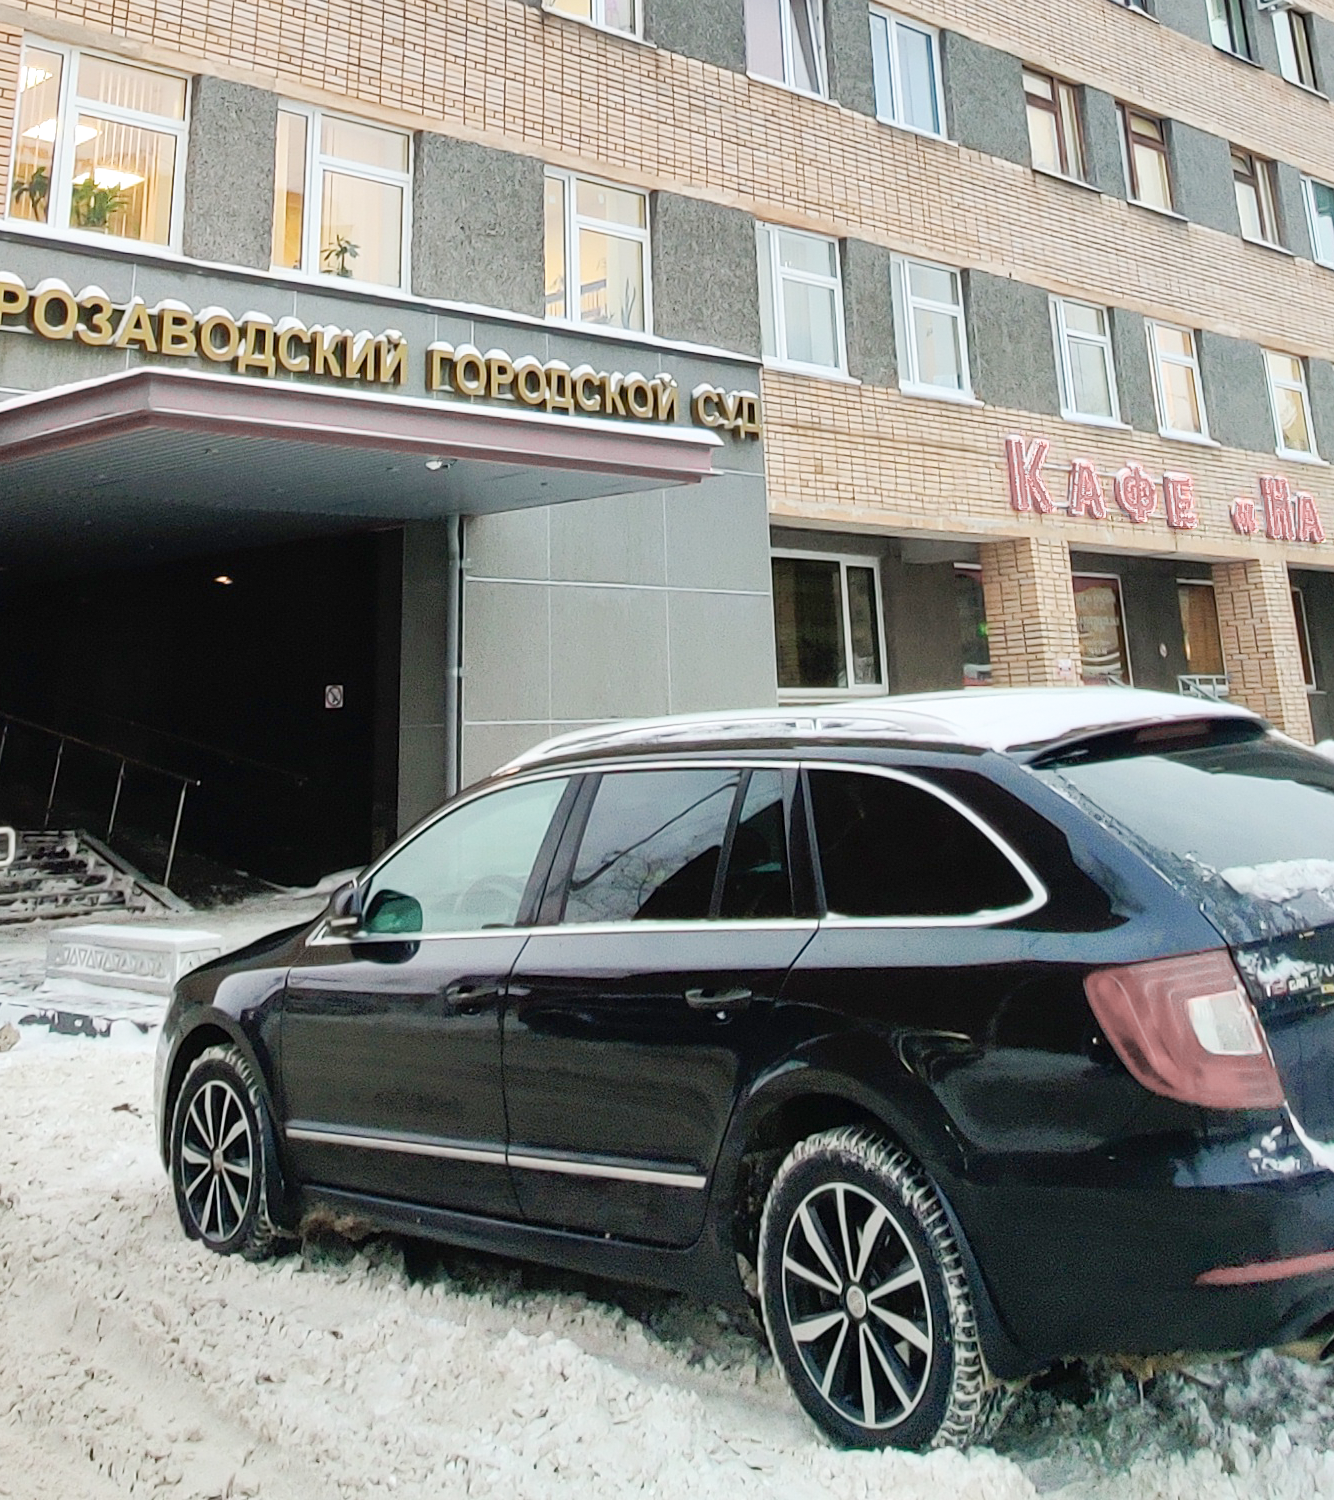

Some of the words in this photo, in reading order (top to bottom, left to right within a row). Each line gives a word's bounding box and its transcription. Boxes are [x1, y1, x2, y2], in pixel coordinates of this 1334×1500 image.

[427, 346, 679, 423] ГОРОДСКОЙ
[693, 387, 763, 440] СУД
[1005, 434, 1199, 530] КАФЕ
